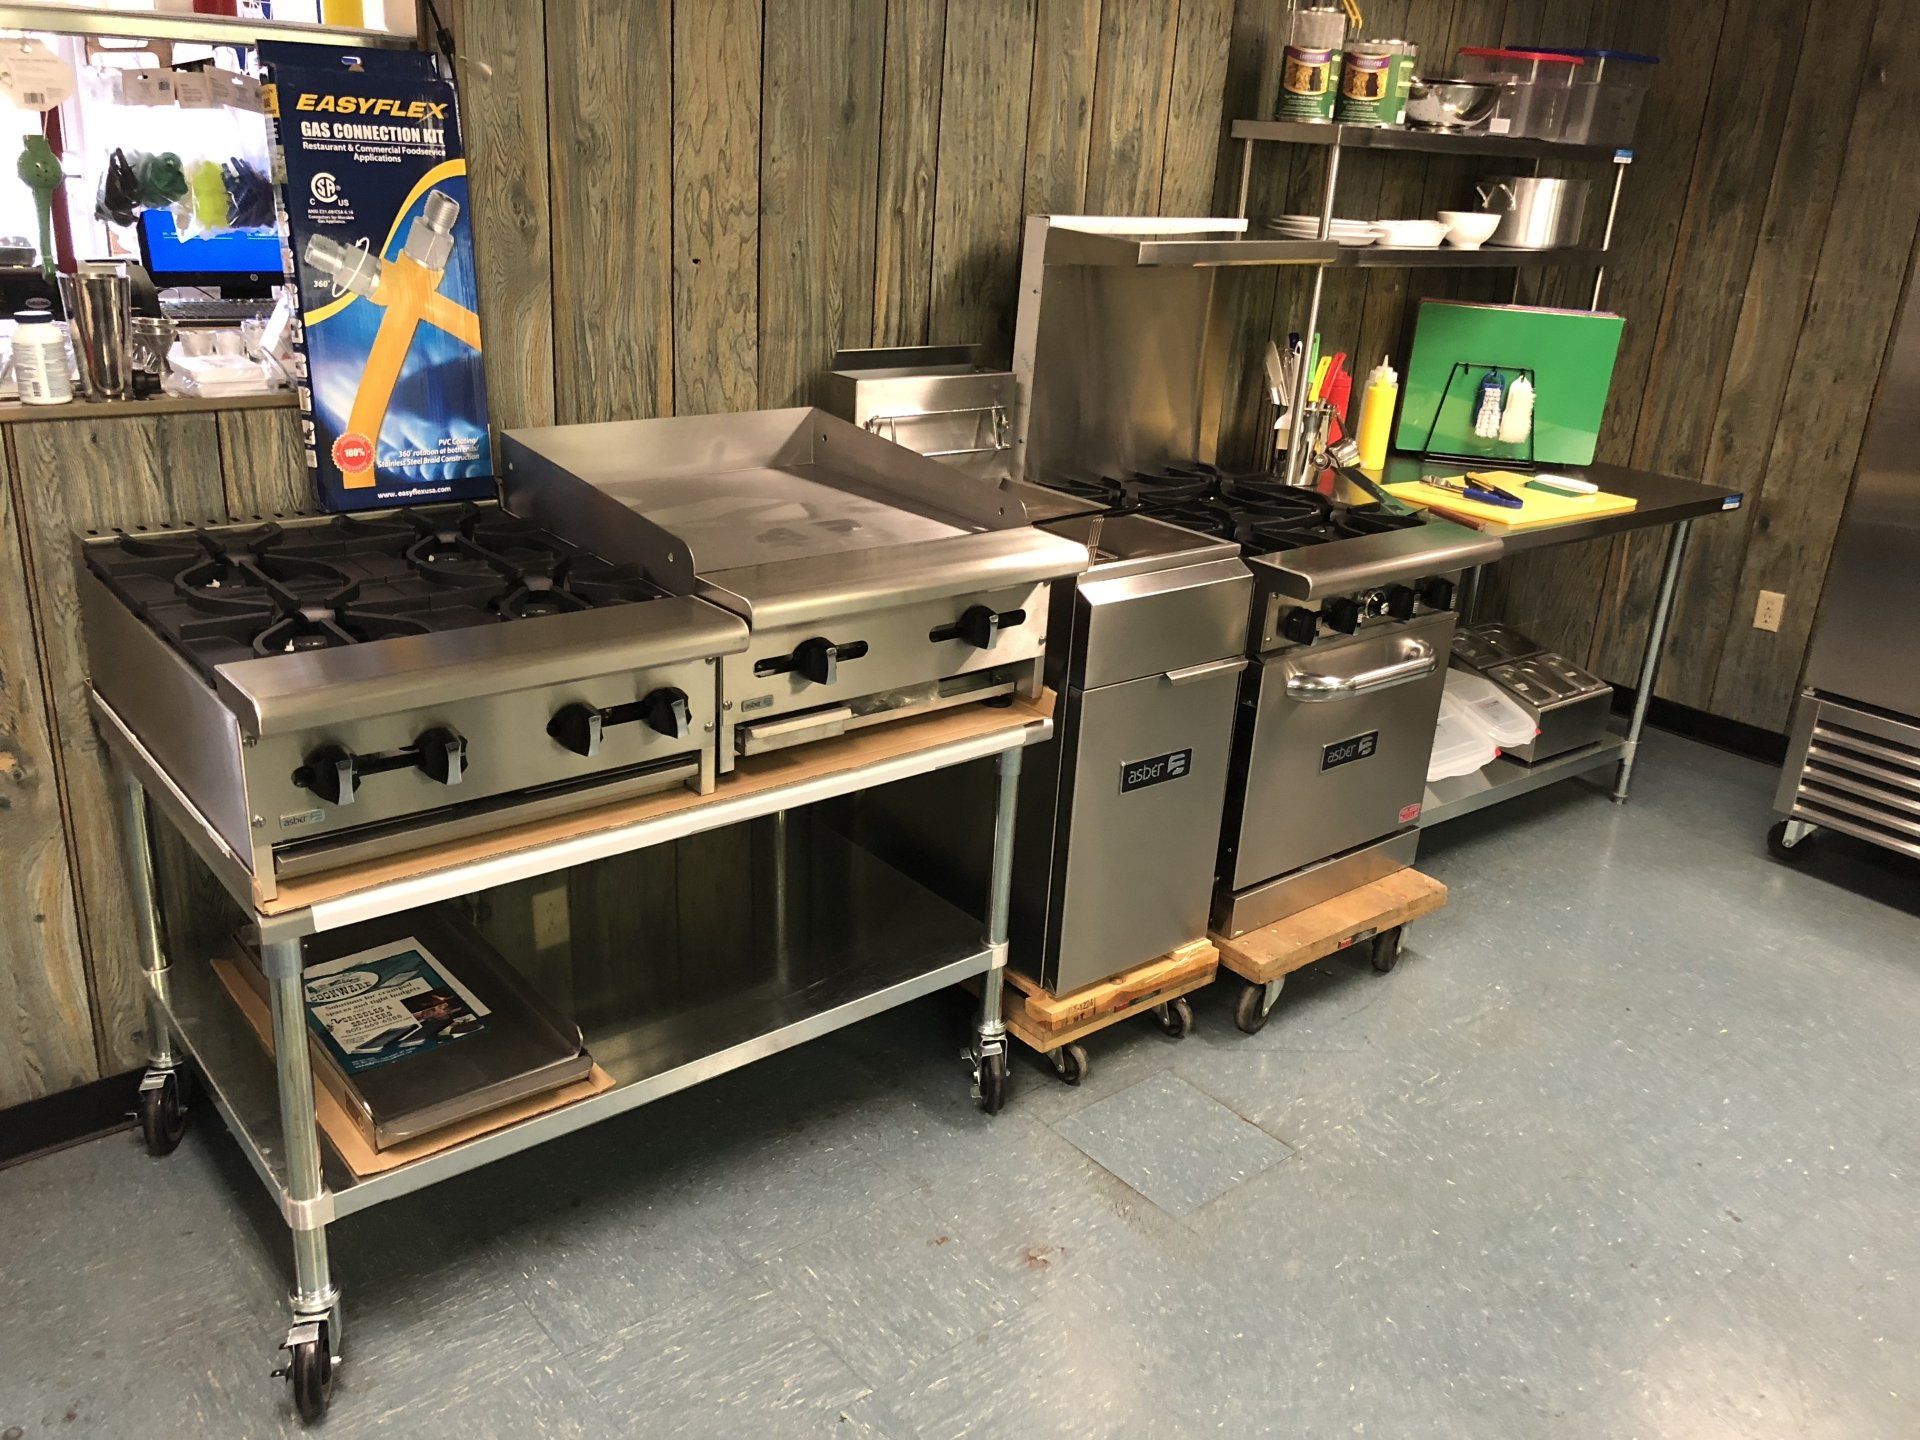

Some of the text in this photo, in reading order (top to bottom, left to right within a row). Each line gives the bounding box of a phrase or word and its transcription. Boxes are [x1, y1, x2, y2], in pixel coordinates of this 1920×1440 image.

[296, 93, 448, 120] EASYFLEX
[300, 121, 445, 144] GAS CONNECTION KIT
[302, 141, 347, 152] Restaurant
[355, 144, 400, 154] Commercial
[402, 147, 446, 157] Foodservice
[353, 153, 401, 163] Applications
[337, 199, 350, 207] US
[438, 438, 451, 446] PVC
[344, 447, 366, 458] 100%
[413, 449, 439, 457] rotation
[447, 446, 459, 454] both
[377, 460, 407, 468] Stainless
[407, 457, 423, 466] Steel
[423, 456, 441, 464] Braid
[441, 453, 480, 463] Construction
[1327, 744, 1357, 763] asber
[1128, 762, 1165, 784] asber
[309, 981, 372, 1002] COOKWARE
